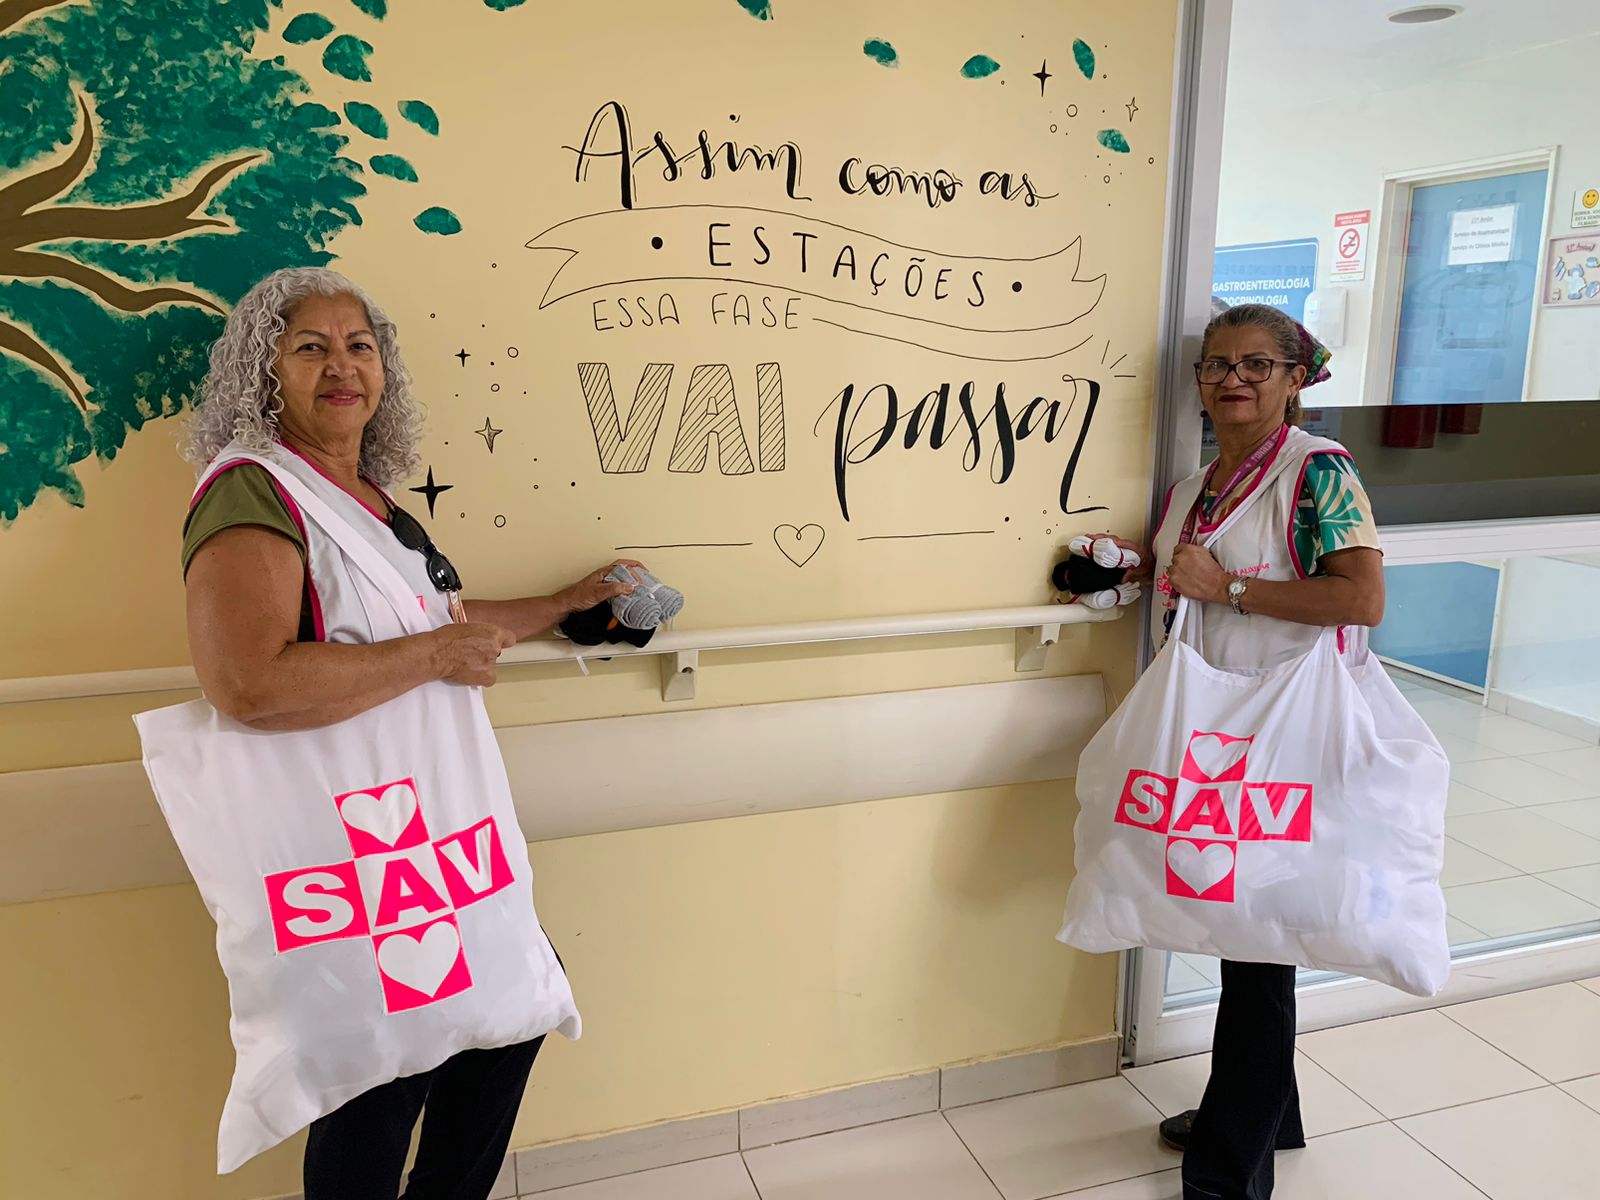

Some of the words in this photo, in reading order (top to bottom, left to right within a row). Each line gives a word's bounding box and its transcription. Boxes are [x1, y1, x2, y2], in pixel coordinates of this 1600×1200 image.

[562, 101, 812, 209] Assim
[838, 157, 963, 208] como
[979, 170, 1059, 208] as
[708, 222, 985, 308] ESTAÇÕES
[1212, 278, 1310, 292] GASTROENTEROLOGIA
[592, 296, 681, 332] ESSA
[712, 293, 802, 330] FASE
[577, 361, 786, 477] VAI
[813, 373, 1110, 523] passar
[1124, 774, 1308, 836] SAV
[282, 822, 492, 938] SAV
